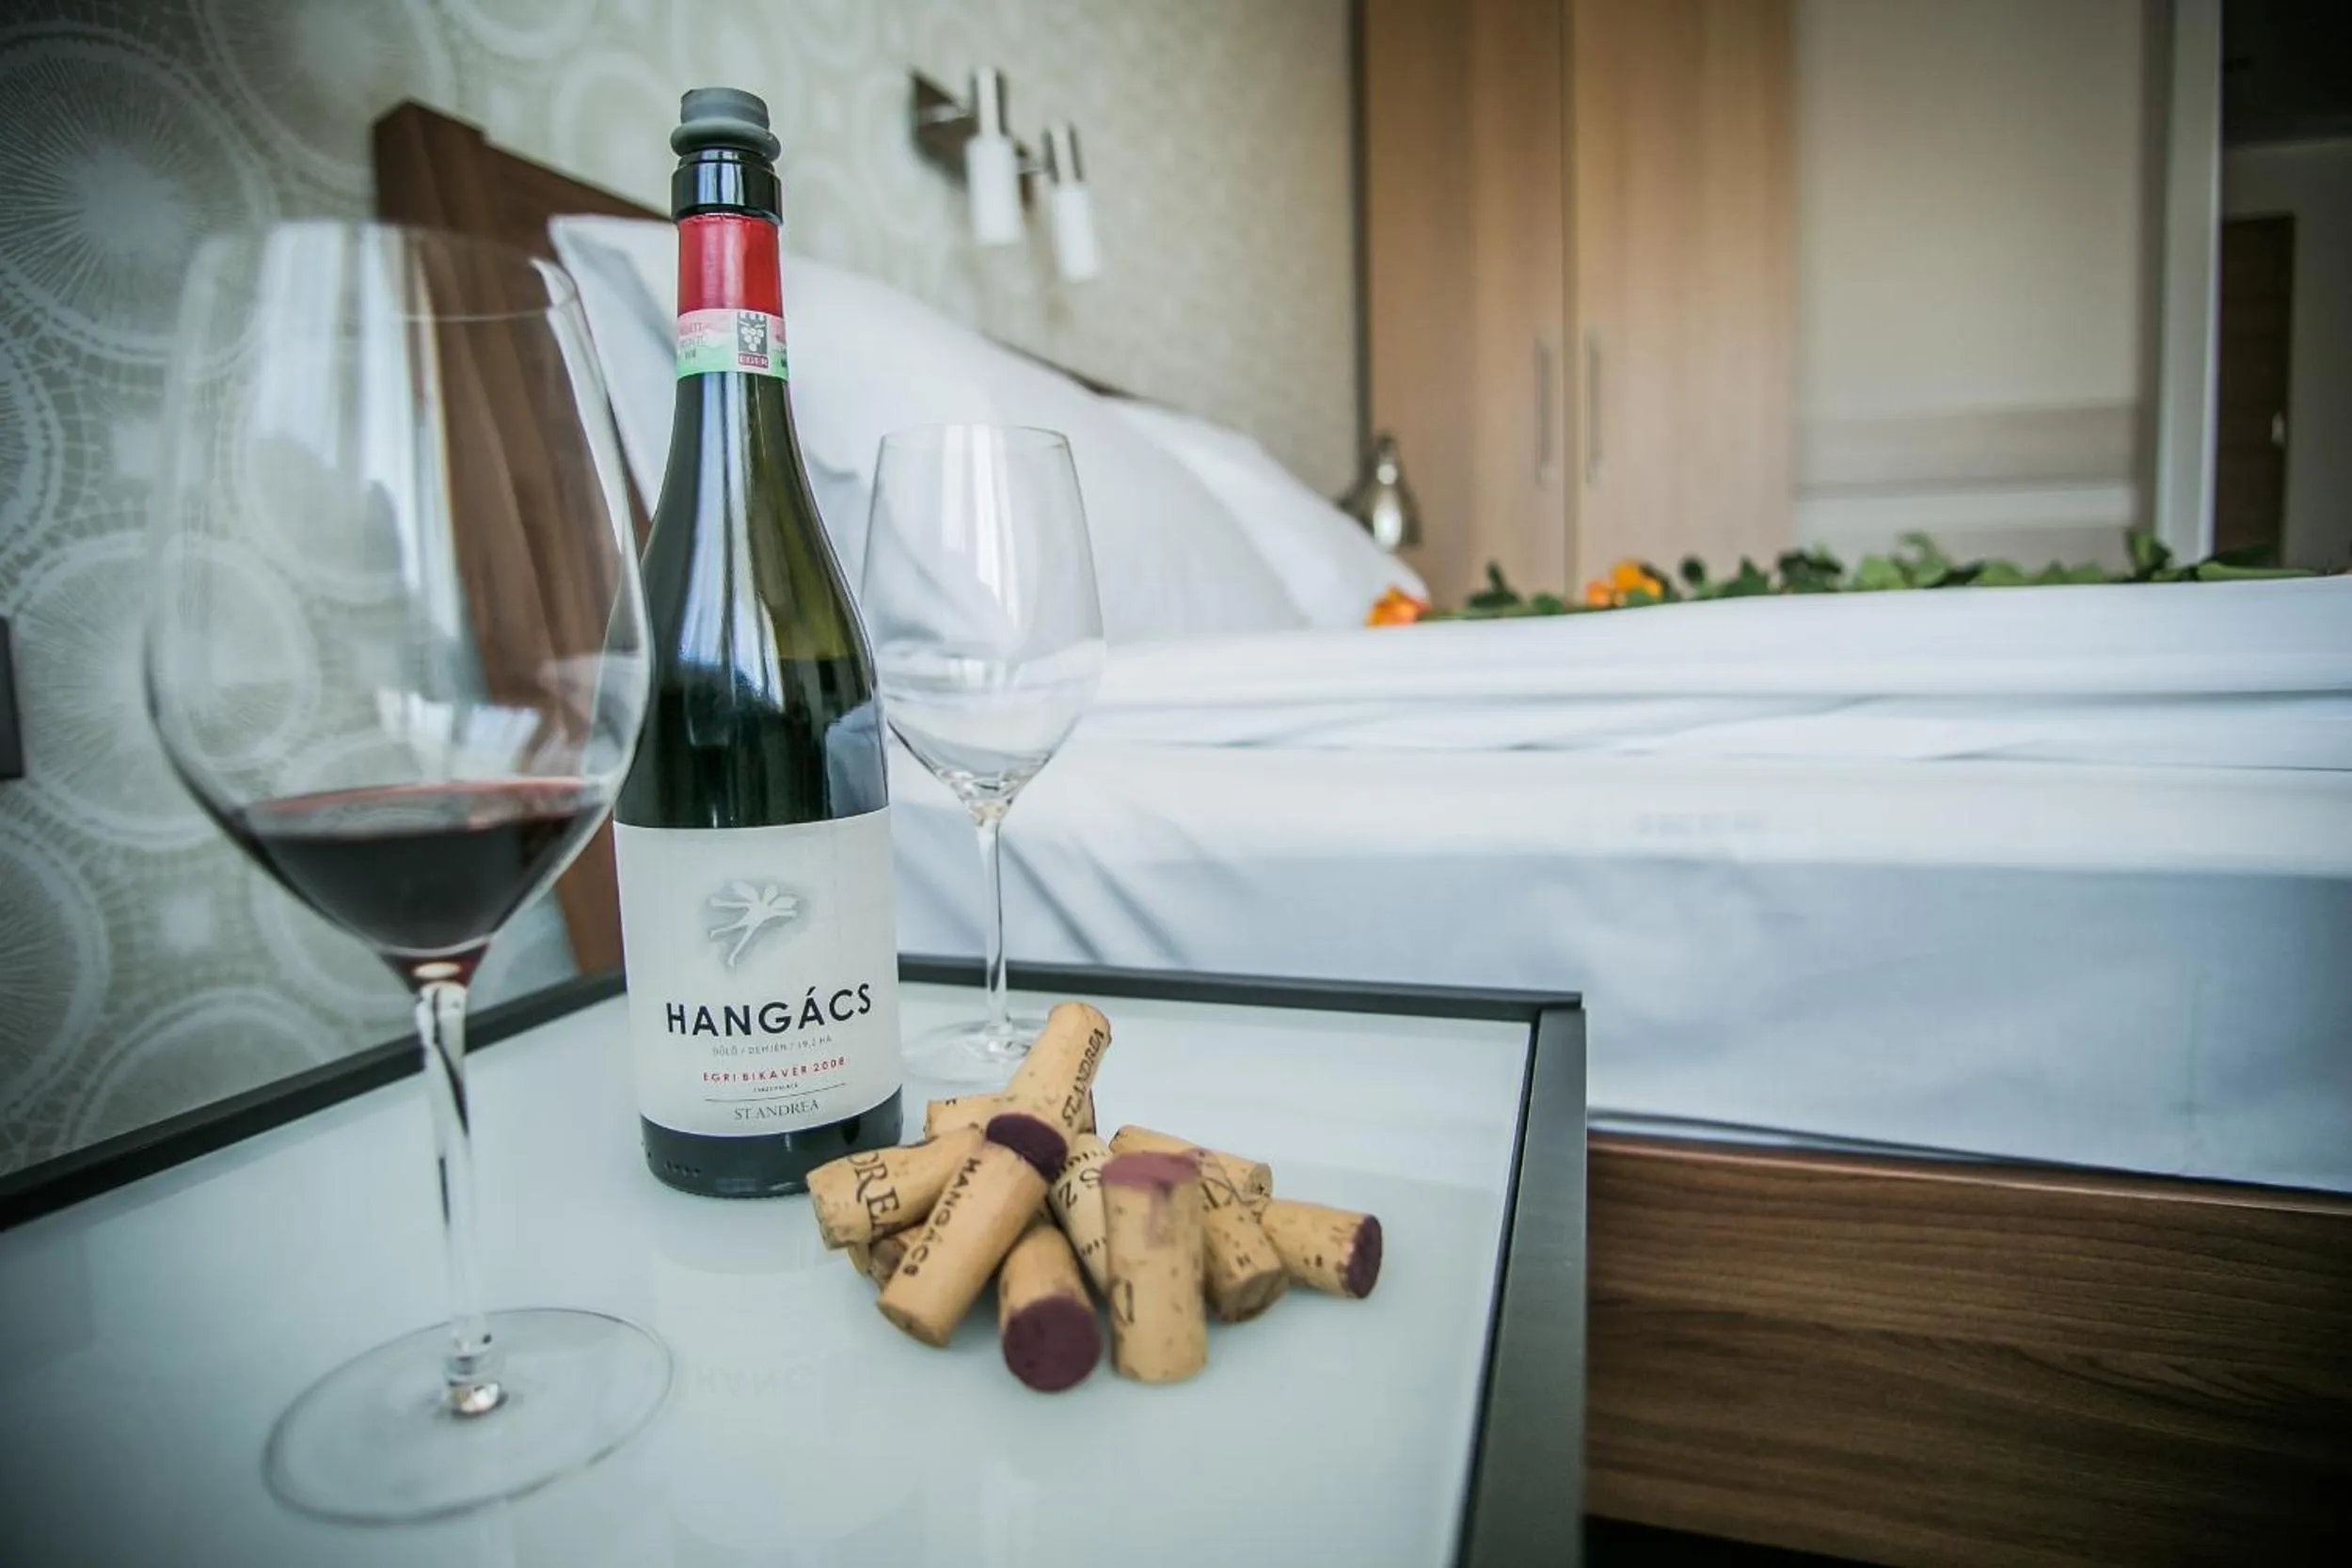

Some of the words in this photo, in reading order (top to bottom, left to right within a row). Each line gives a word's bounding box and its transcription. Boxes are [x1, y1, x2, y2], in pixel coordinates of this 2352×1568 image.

[665, 983, 871, 1037] HANGÁCS
[703, 1071, 737, 1083] EGRI
[813, 1055, 846, 1072] 2008
[755, 1099, 819, 1119] ANDREA
